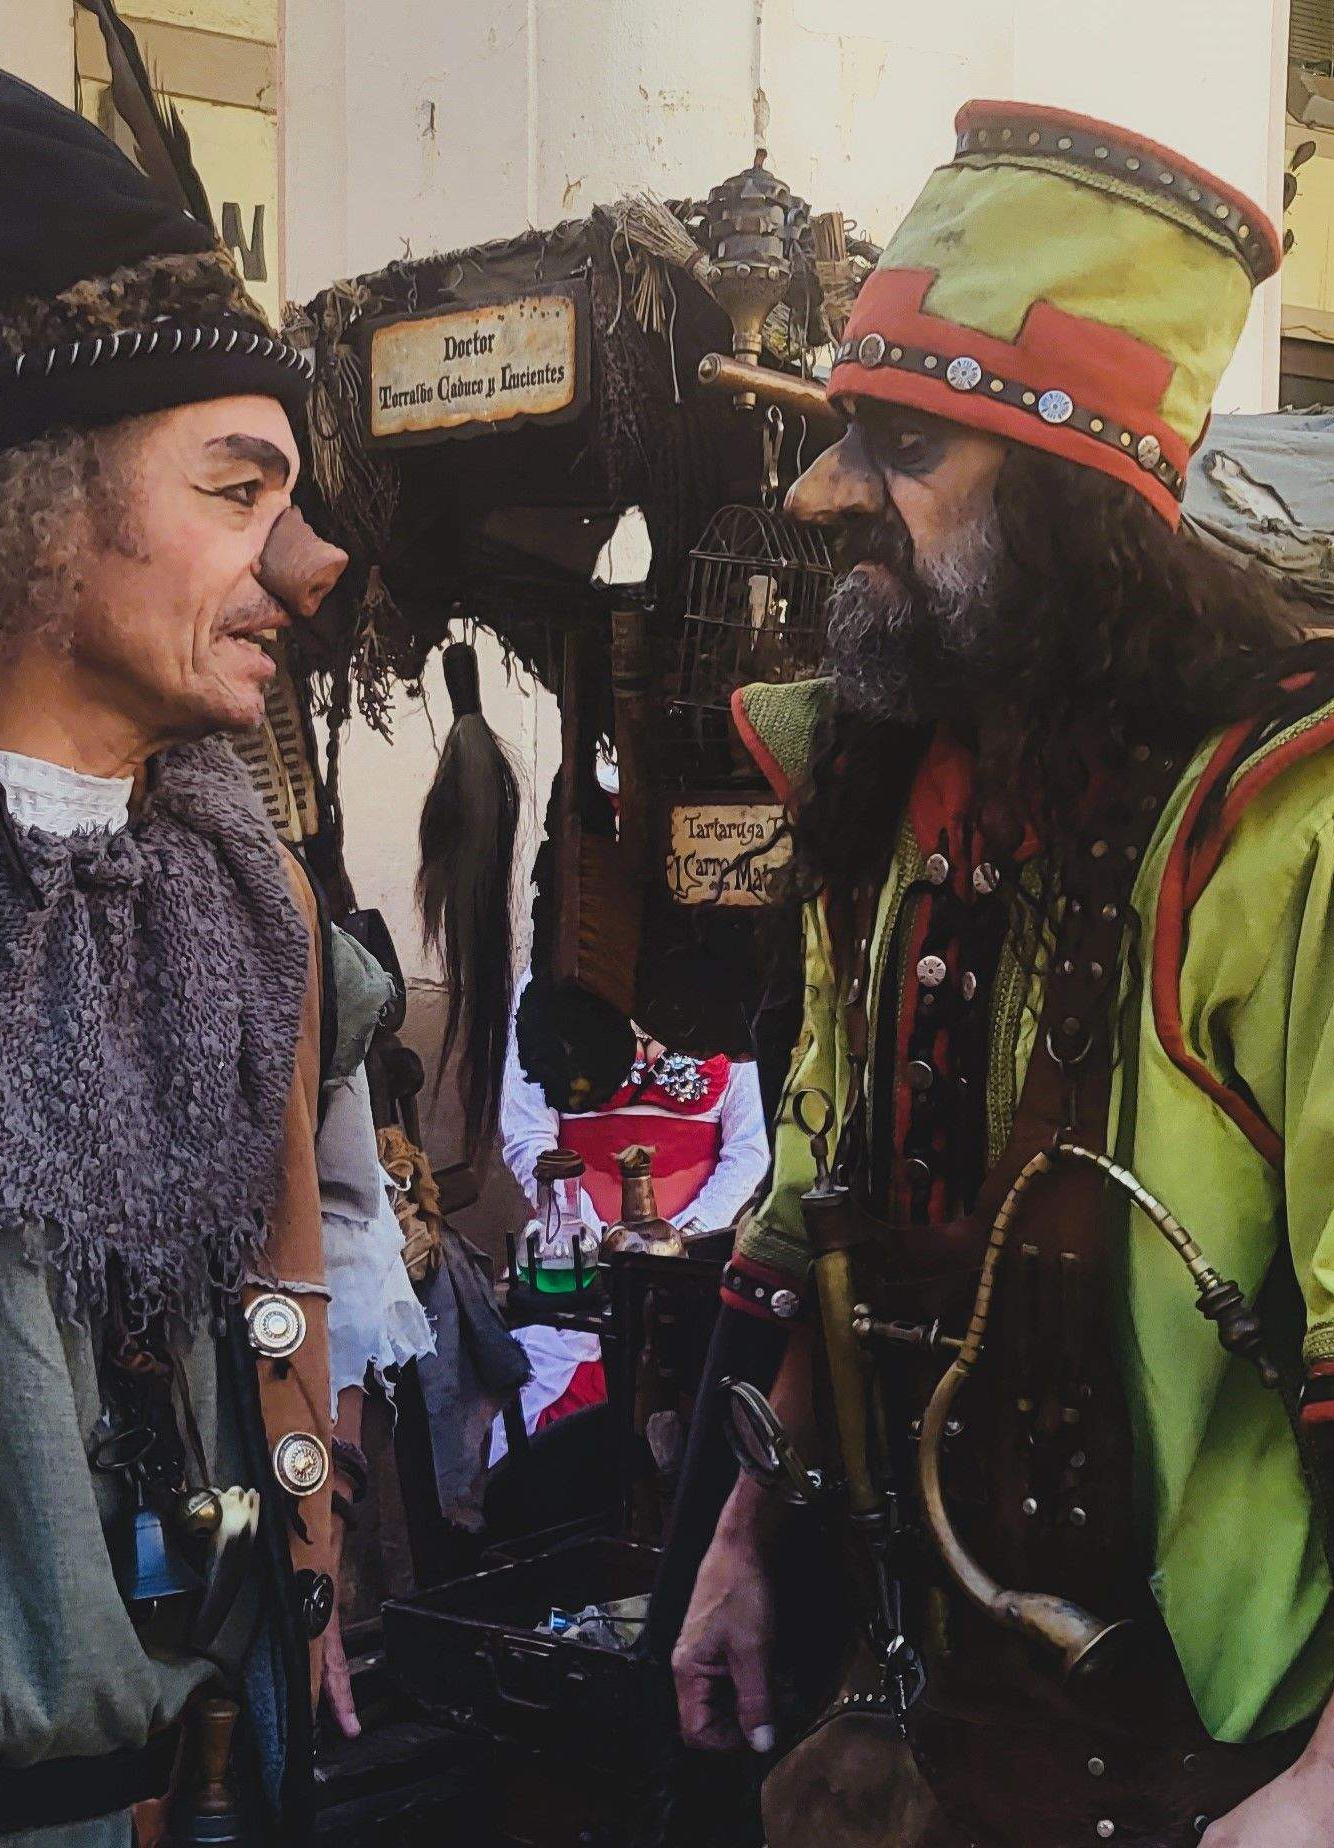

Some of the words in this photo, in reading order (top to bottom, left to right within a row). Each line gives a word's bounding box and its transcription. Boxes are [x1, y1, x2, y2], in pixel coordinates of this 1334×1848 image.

[443, 330, 496, 362] Doctor
[379, 383, 434, 411] Torralbo
[485, 376, 496, 398] y
[500, 362, 565, 391] Lucientes
[683, 812, 764, 846] Tartaruga
